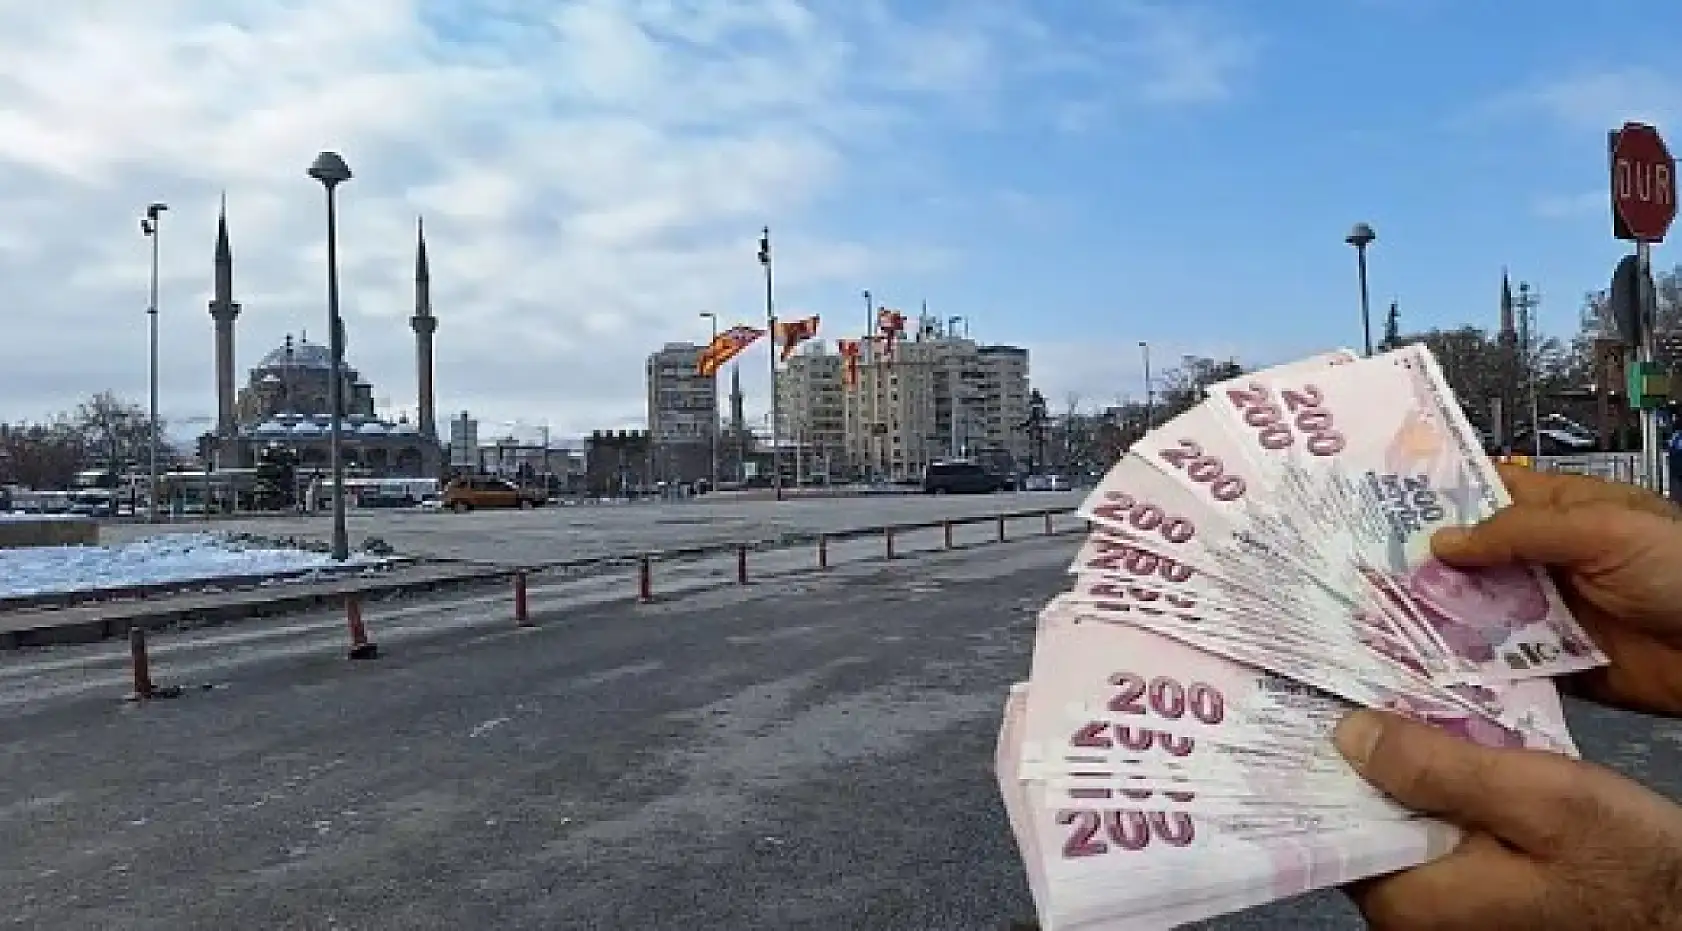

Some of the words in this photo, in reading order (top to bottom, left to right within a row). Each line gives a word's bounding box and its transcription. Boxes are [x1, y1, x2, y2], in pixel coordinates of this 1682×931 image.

[1617, 159, 1670, 204] DUR
[1226, 383, 1294, 449] 200
[1281, 384, 1345, 456] 200
[1158, 438, 1246, 501] 200
[1092, 490, 1195, 543] 200
[1107, 671, 1223, 725] 200
[1056, 808, 1195, 858] 200
